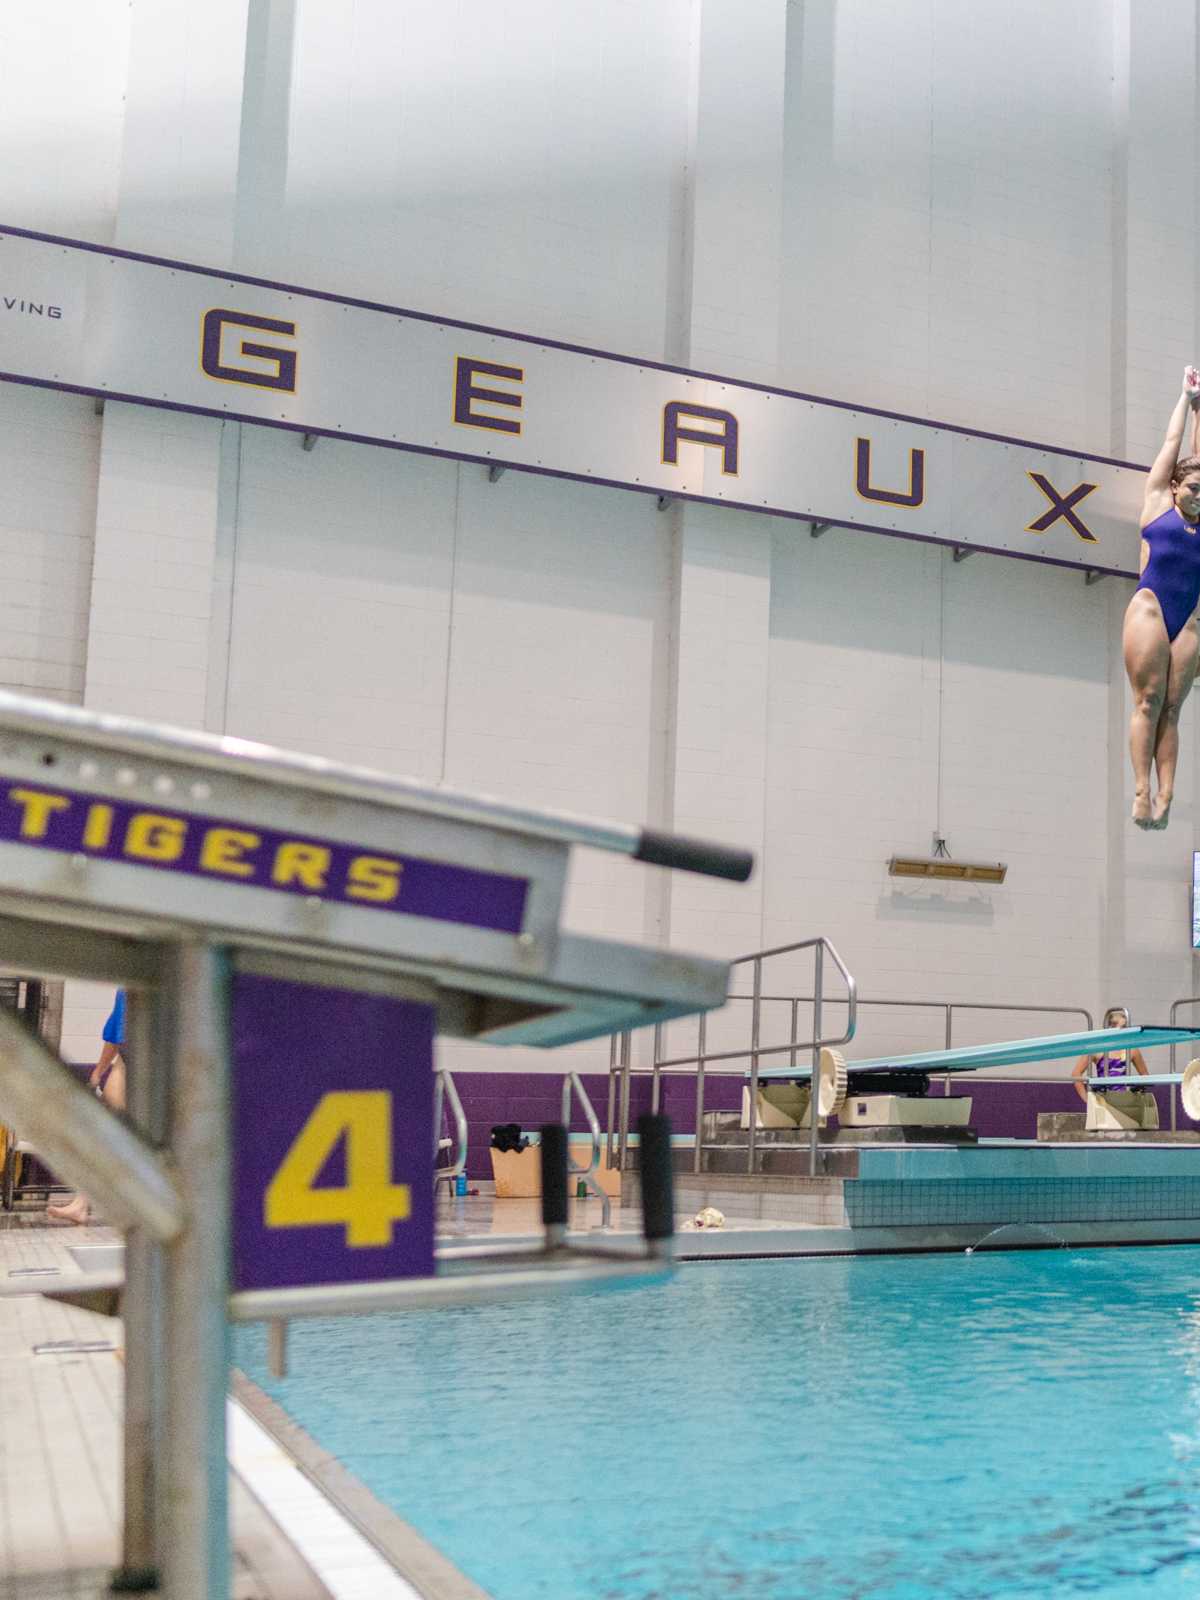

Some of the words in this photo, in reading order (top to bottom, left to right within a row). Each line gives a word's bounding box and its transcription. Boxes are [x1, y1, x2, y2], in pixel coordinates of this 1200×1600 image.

[3, 296, 63, 319] VING
[7, 787, 404, 902] TIGERS
[263, 1090, 412, 1248] 4
